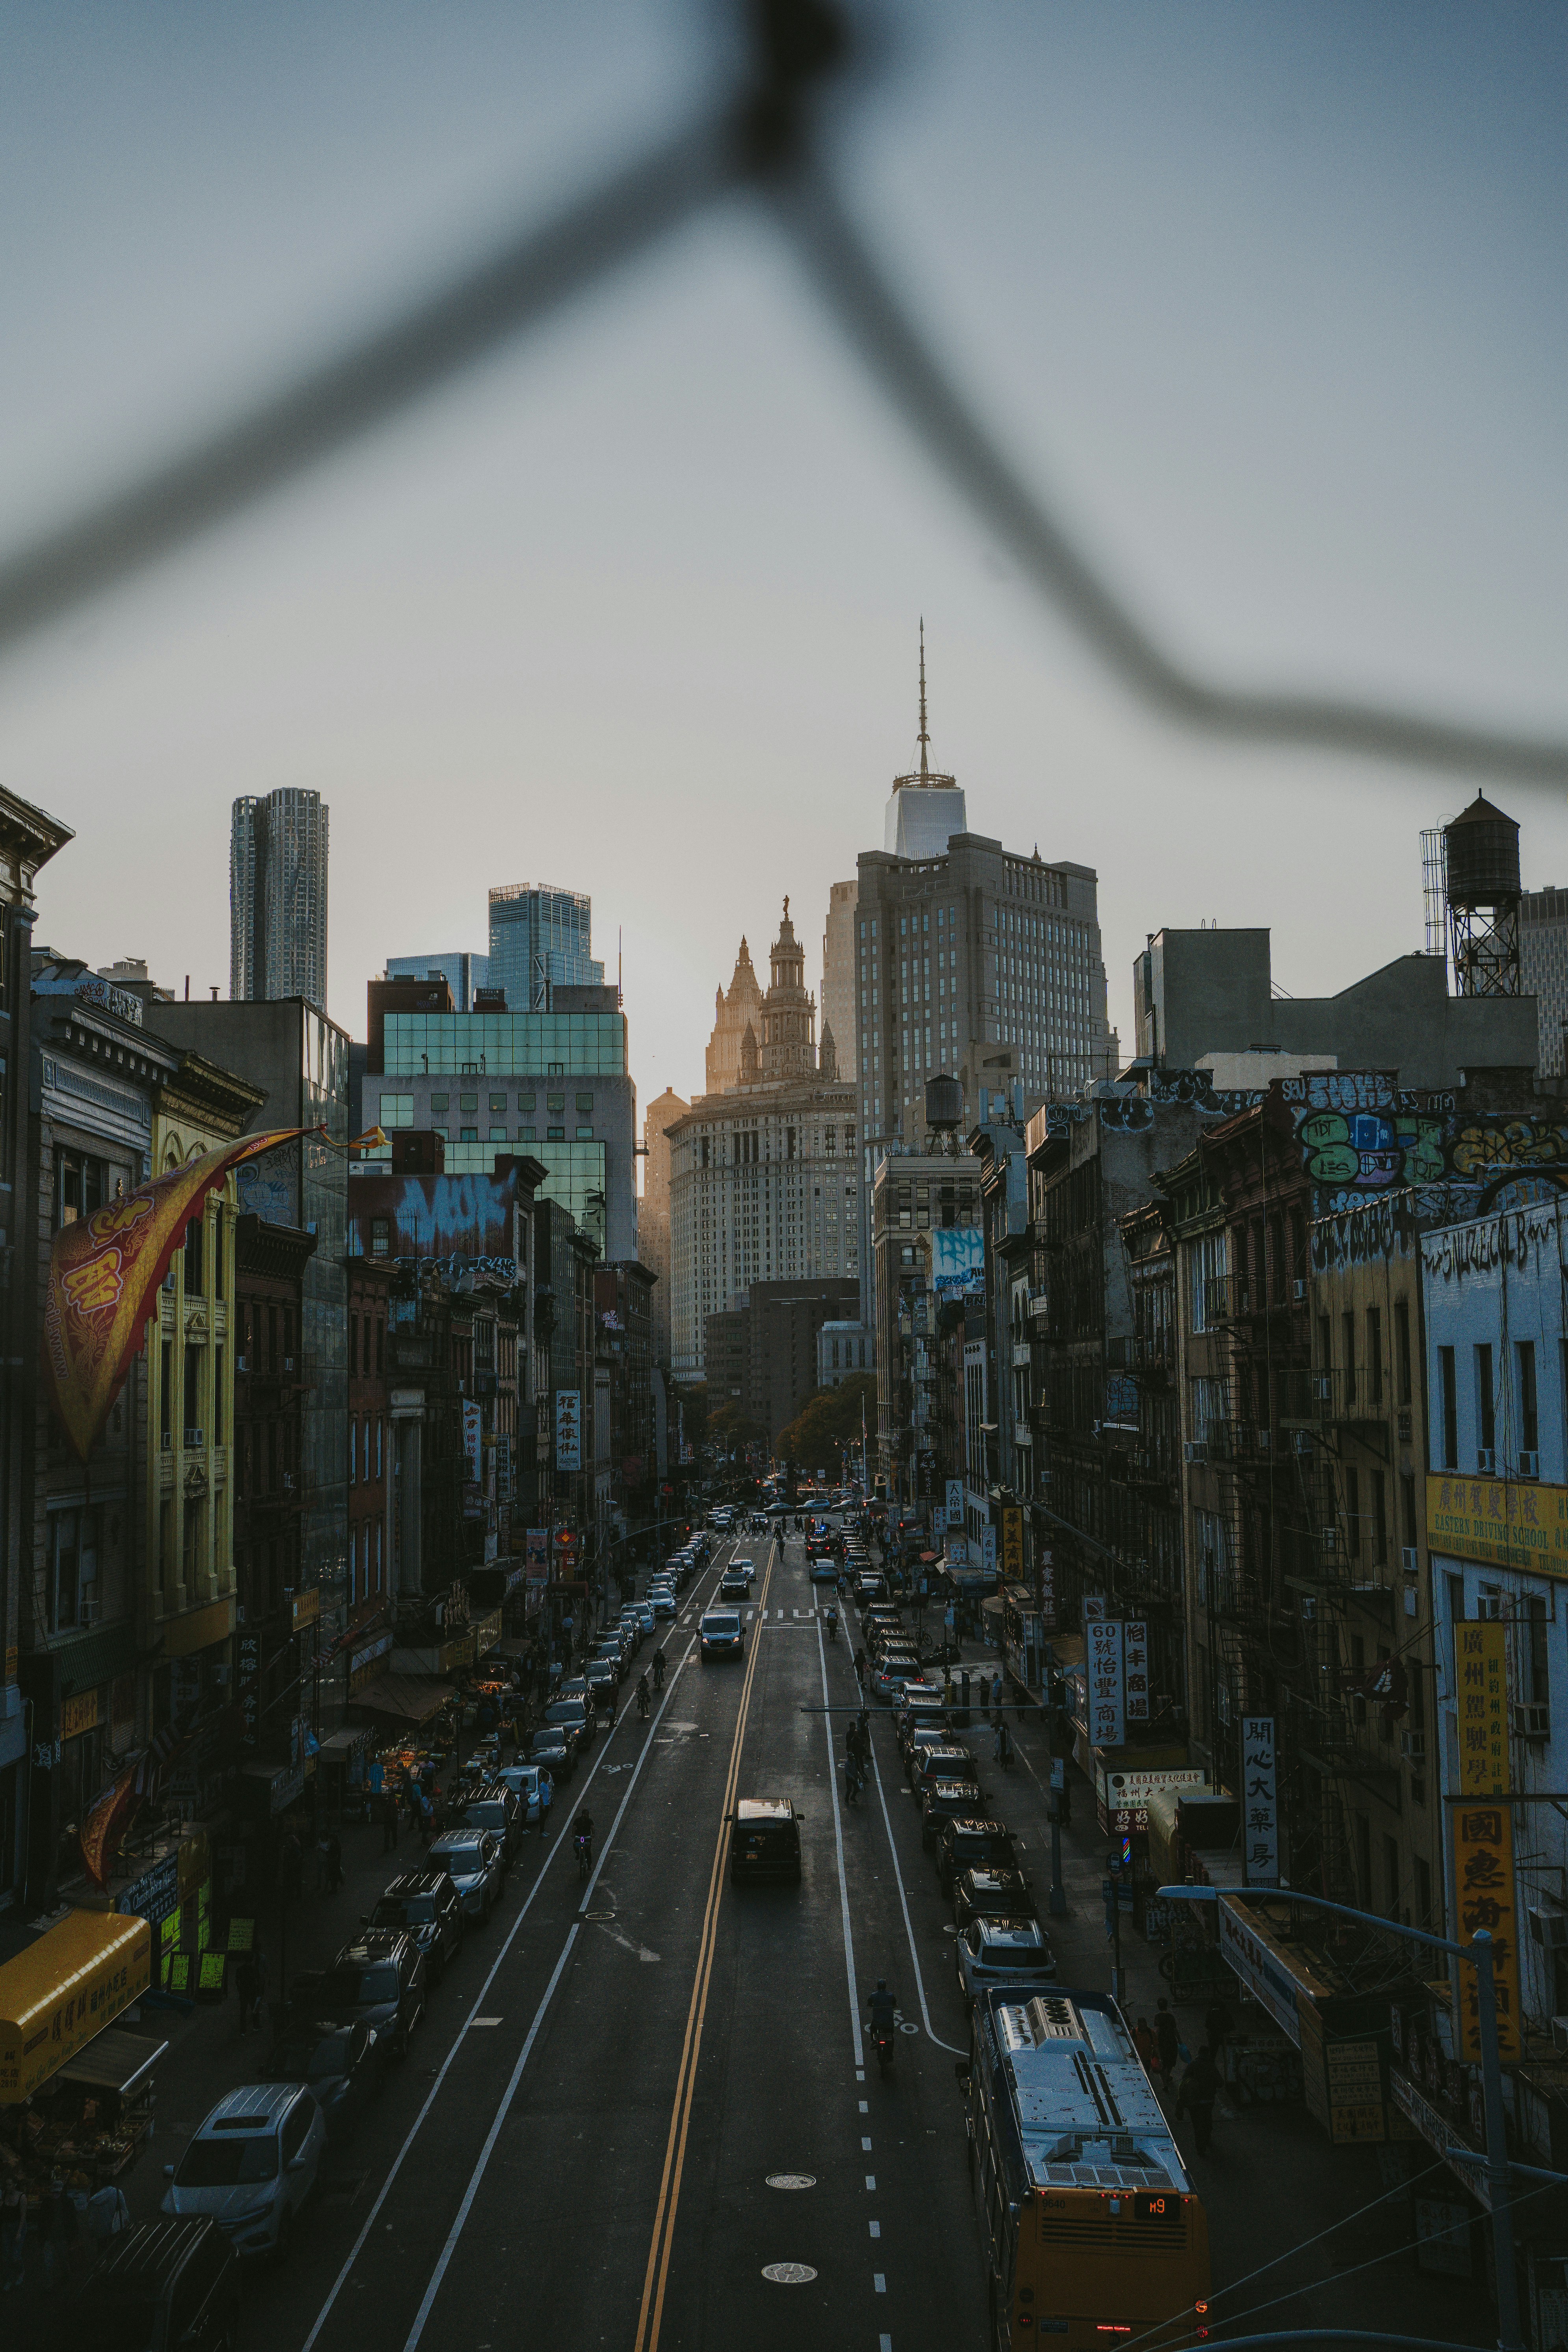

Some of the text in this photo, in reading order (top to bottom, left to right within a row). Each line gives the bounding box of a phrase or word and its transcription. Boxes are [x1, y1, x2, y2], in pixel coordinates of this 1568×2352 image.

[949, 1483, 960, 1521] 大帝國
[1005, 1511, 1021, 1578] 華美商場
[1435, 1514, 1470, 1535] EASTERN
[1473, 1519, 1509, 1542] DRIVING
[1513, 1526, 1549, 1550] SCHOOL
[1041, 1551, 1055, 1615] 農家飯莊
[1093, 1626, 1119, 1742] 60號怡豐商場
[1464, 1630, 1488, 1790] 廣州駕駛學
[1246, 1722, 1274, 1868] 開心大藥房
[133, 1877, 162, 1912] Christopher
[1042, 2198, 1065, 2209] 9640
[1150, 2199, 1165, 2213] M9
